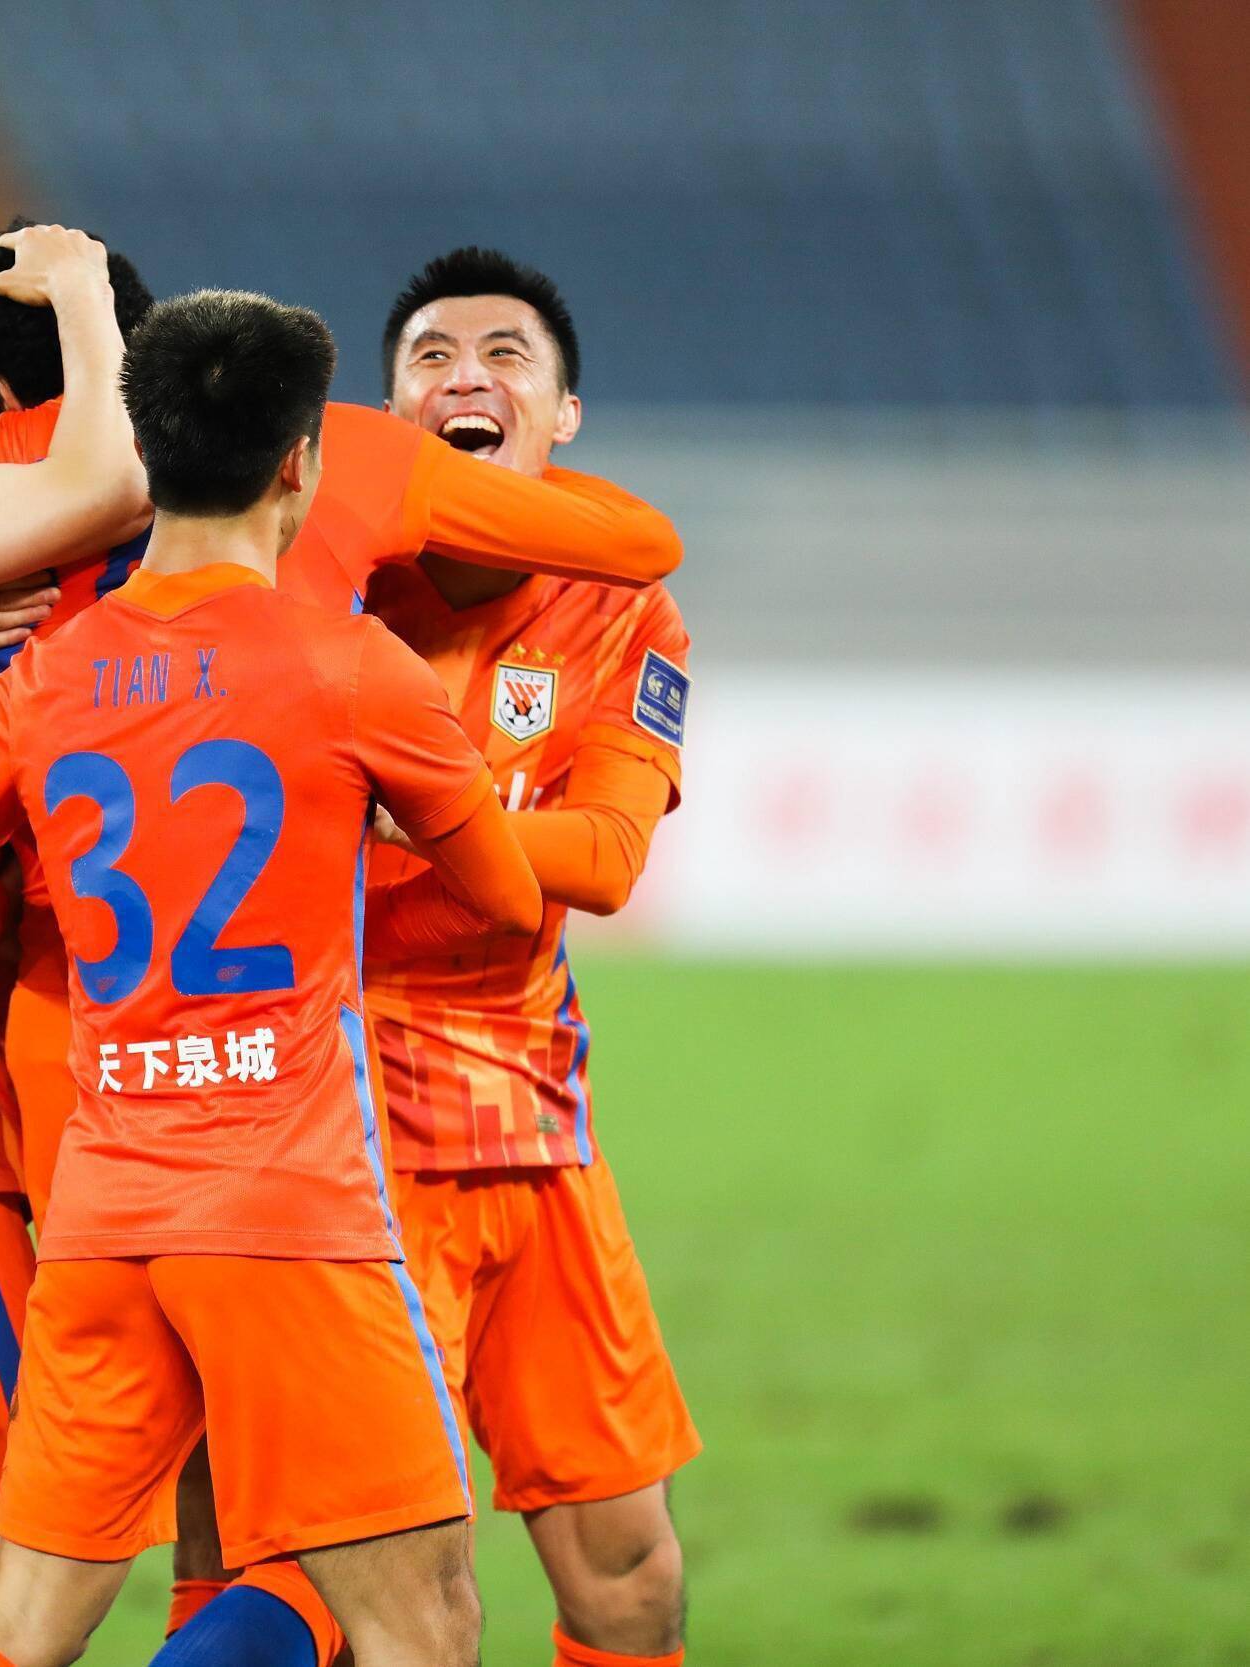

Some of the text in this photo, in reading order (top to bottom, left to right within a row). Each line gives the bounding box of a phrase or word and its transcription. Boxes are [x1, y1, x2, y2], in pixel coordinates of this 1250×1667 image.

[92, 648, 228, 708] TIAN X.
[44, 738, 296, 1005] 32
[98, 1027, 277, 1094] 天下泉城
